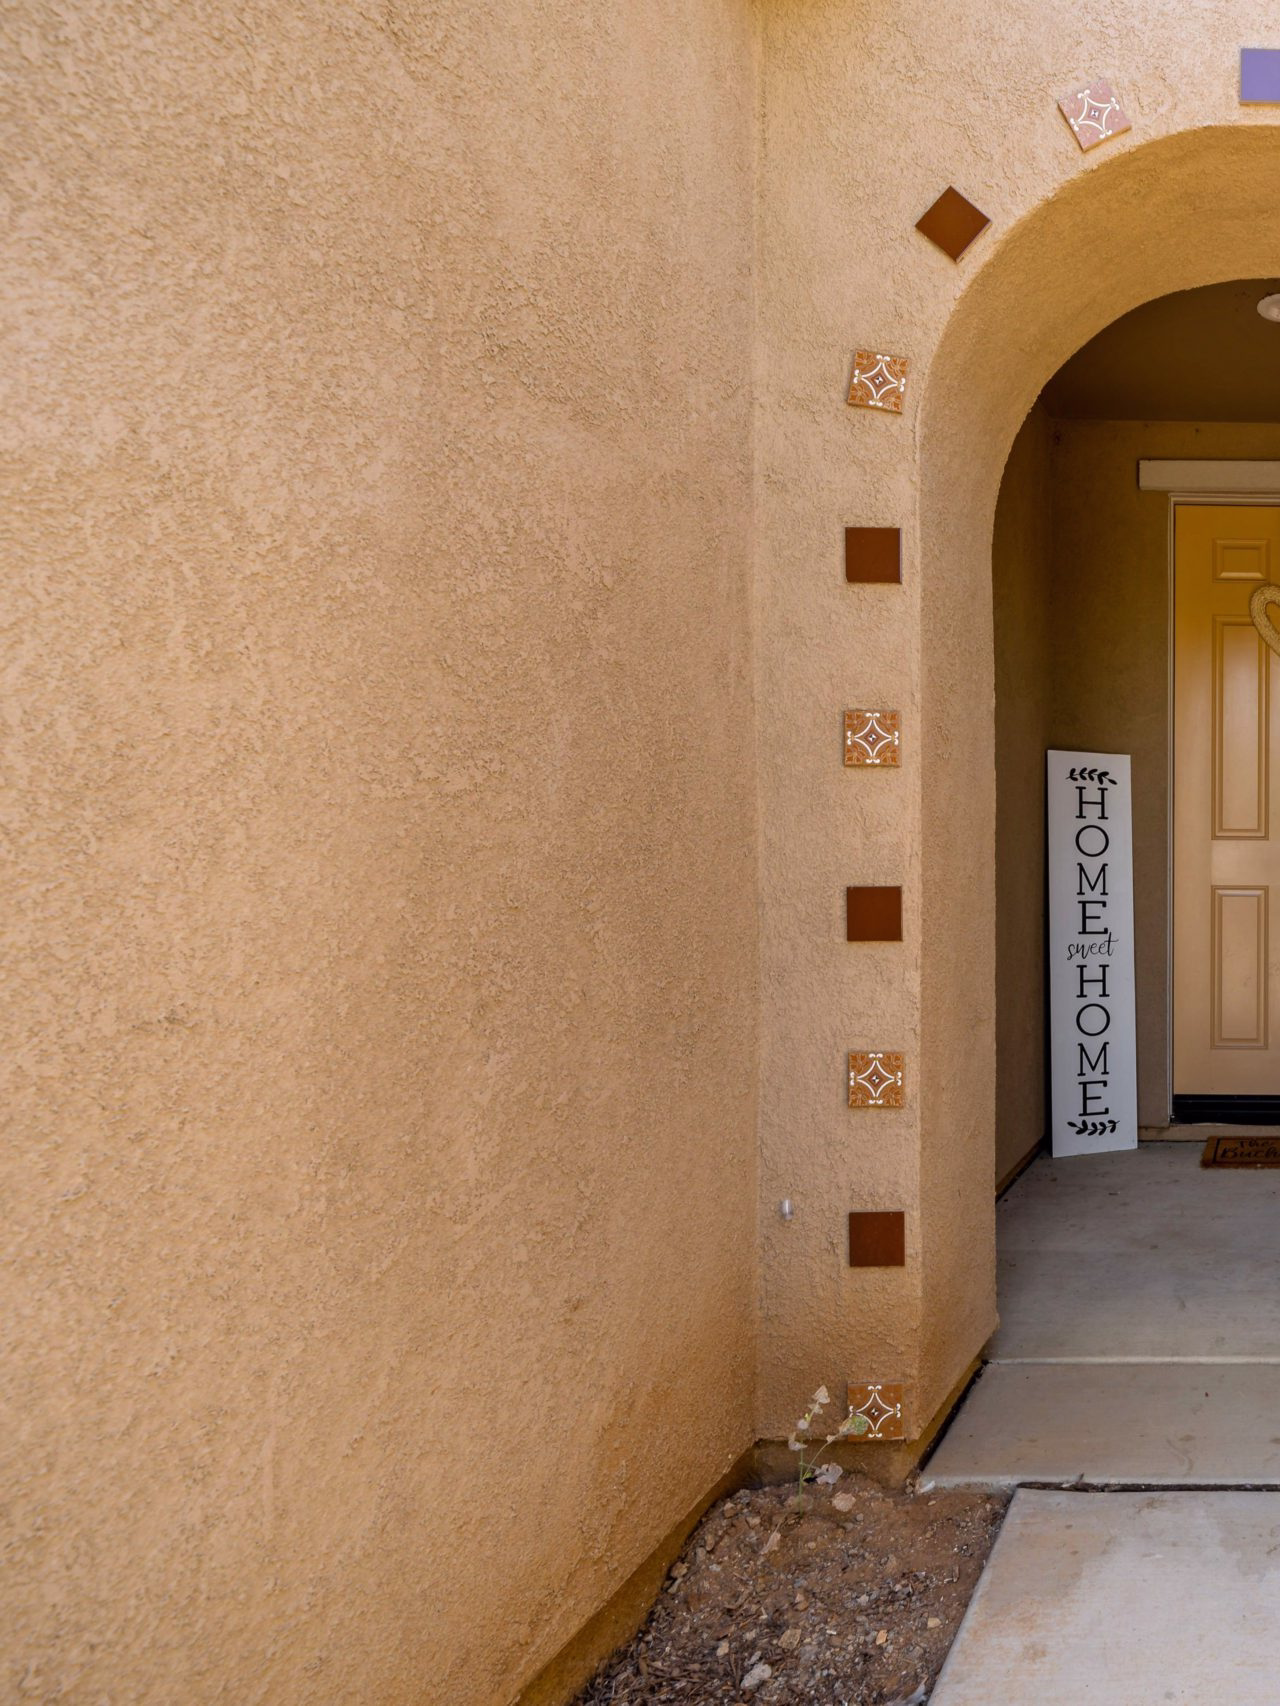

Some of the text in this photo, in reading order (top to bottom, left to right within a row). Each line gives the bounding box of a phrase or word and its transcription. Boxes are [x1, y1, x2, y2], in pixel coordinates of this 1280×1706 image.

[1075, 786, 1110, 935] HOME
[1066, 932, 1119, 960] sweet
[1075, 964, 1111, 1117] HOME
